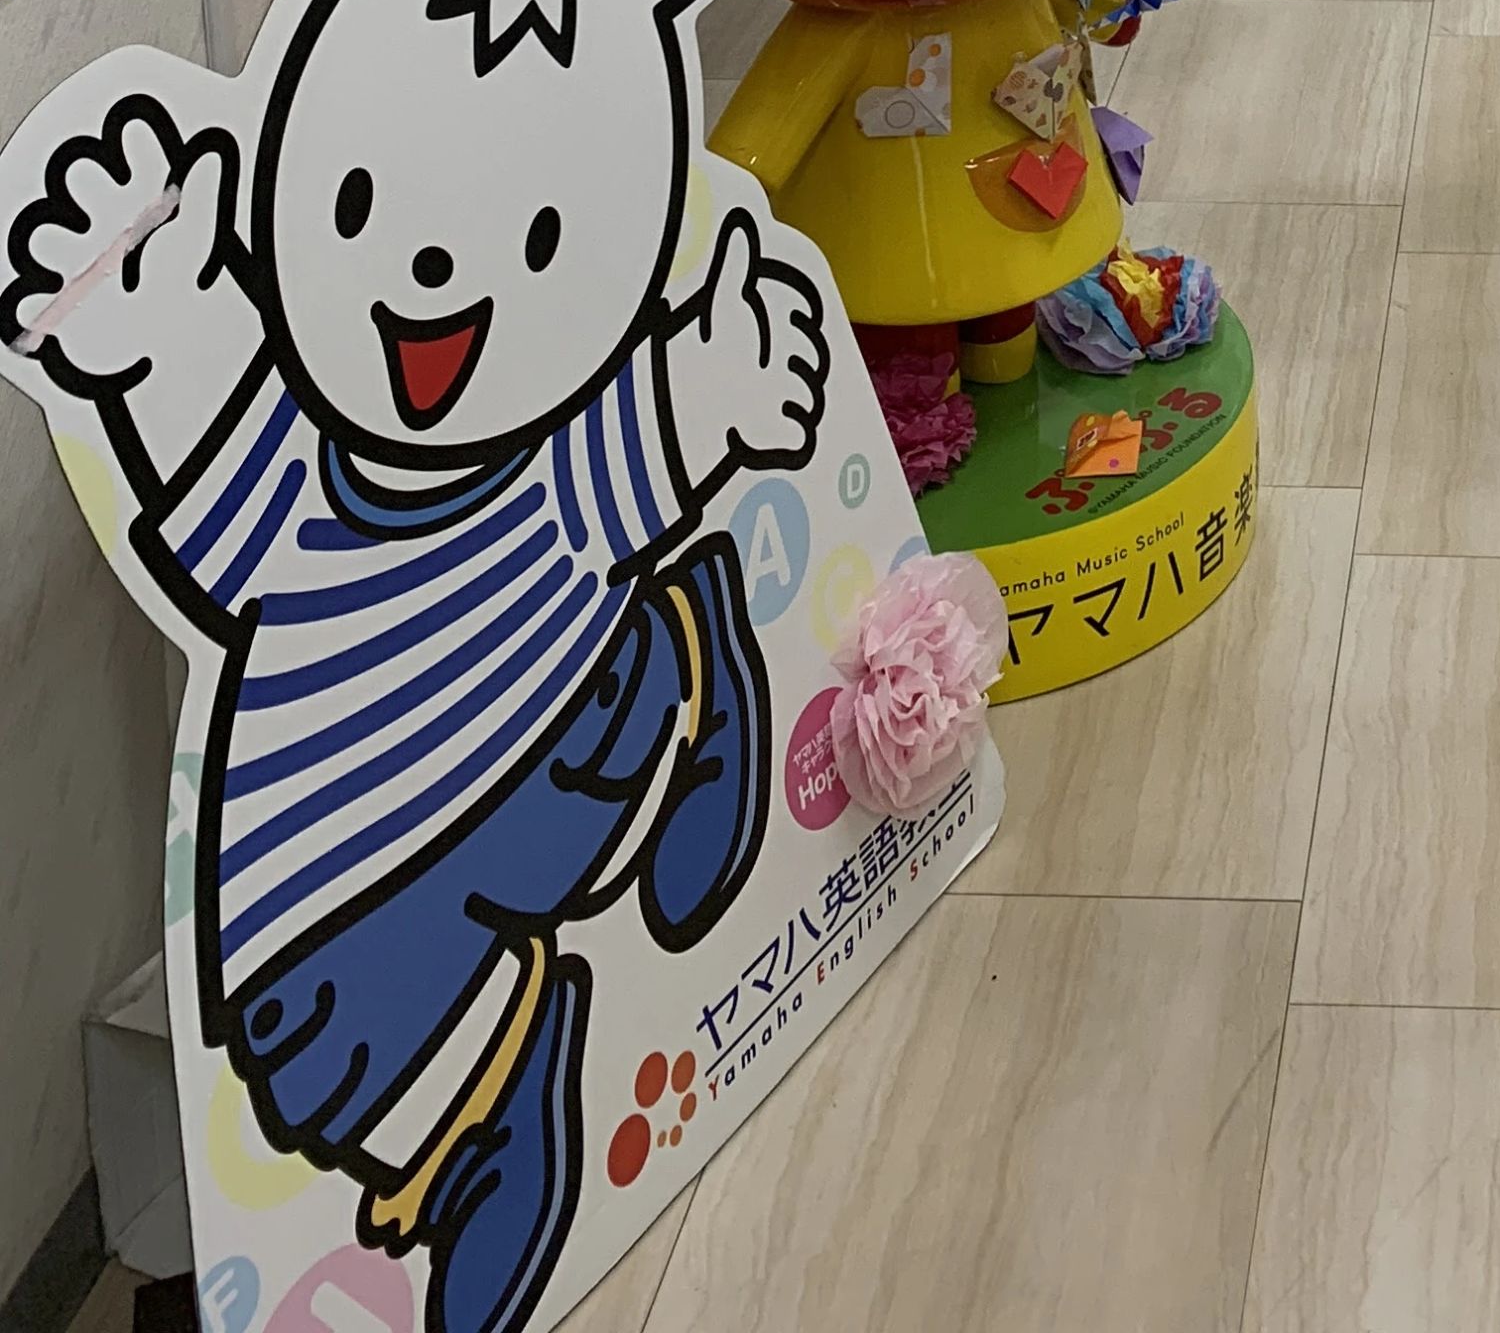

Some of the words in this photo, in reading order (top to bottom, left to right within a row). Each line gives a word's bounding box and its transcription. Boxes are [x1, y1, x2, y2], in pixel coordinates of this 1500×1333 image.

[845, 462, 865, 500] D
[1025, 387, 1223, 516] ぷぷる
[745, 502, 792, 589] A
[1000, 571, 1065, 598] amaha
[1076, 546, 1129, 577] Music
[1135, 512, 1185, 552] School
[706, 993, 805, 1103] Yamaha
[815, 885, 898, 986] English
[909, 793, 975, 882] School
